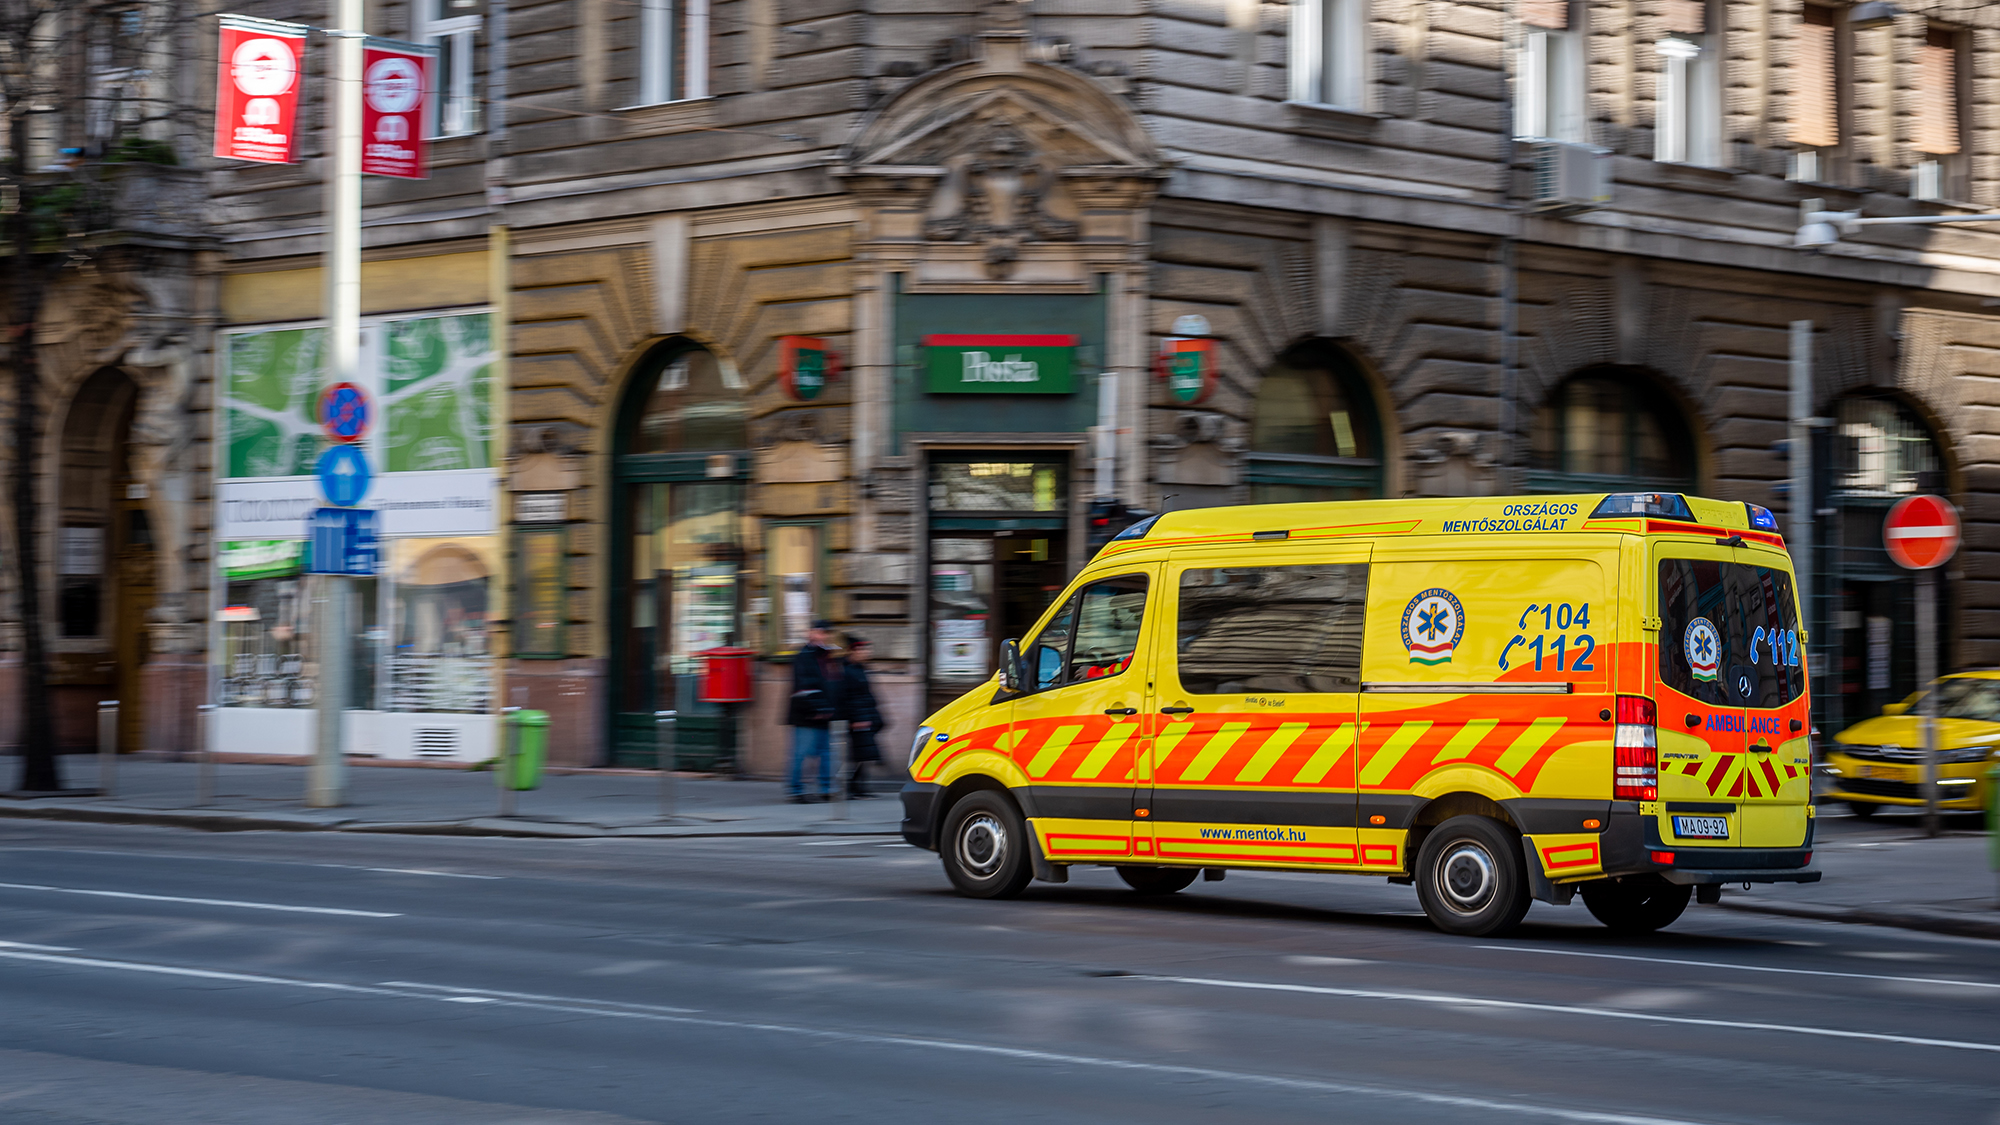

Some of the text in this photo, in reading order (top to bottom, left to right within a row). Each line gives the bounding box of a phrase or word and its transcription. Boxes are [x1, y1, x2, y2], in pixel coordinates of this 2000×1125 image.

[960, 351, 1041, 382] Posta
[1503, 502, 1578, 516] ORSZÁGOS
[1442, 516, 1568, 533] MENTŐSZOLGÁLAT
[1402, 597, 1420, 646] ORSZÁGOS
[1540, 603, 1590, 630] 104
[1528, 634, 1596, 672] 112
[1767, 627, 1799, 667] 112
[1705, 714, 1781, 735] AMBULANCE
[1200, 827, 1306, 842] www.mentok.hu
[1682, 818, 1726, 835] MA 09-92
